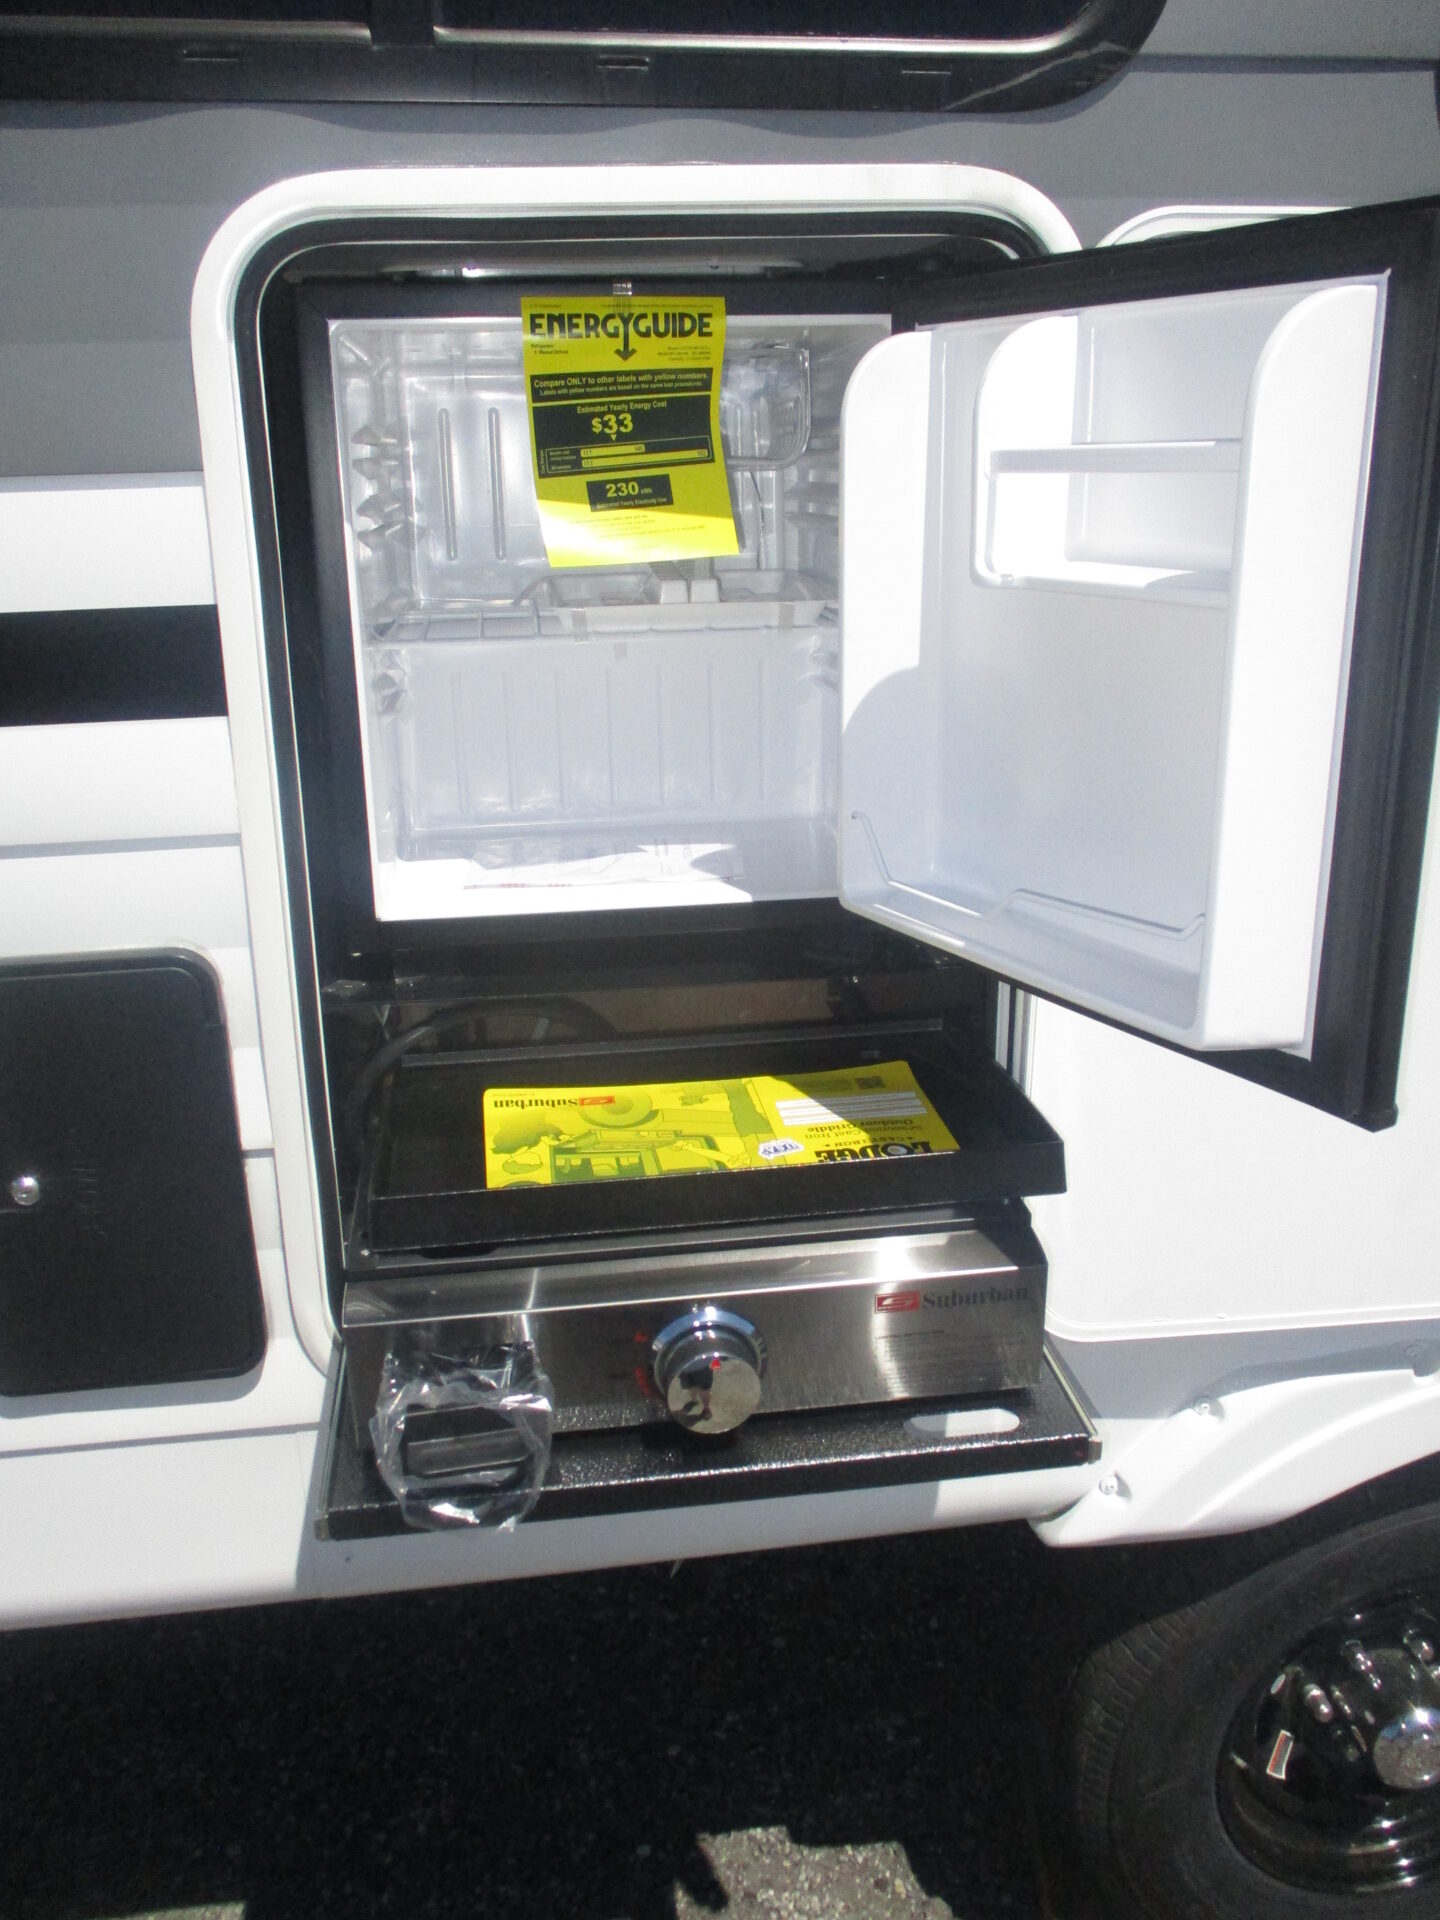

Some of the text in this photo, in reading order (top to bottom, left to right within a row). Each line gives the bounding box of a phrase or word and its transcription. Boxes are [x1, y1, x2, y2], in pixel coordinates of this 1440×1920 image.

[530, 312, 713, 339] ENERGYGUIDE
[534, 379, 565, 389] Compare
[566, 377, 587, 386] ONLY
[596, 376, 614, 384] other
[616, 375, 636, 383] labels
[654, 373, 676, 382] yellow
[569, 388, 585, 396] yellow
[577, 400, 667, 414] Estimated Yearly Energy Cost
[591, 413, 634, 434] $33
[606, 481, 639, 498] 230
[493, 1098, 578, 1109] Suburban
[807, 1118, 914, 1133] Outdoor Griddle
[832, 1128, 861, 1138] Cast
[804, 1132, 832, 1140] Iron
[834, 1138, 868, 1147] IRON
[814, 1141, 933, 1162] LODGE
[923, 1287, 1028, 1309] Suburban
